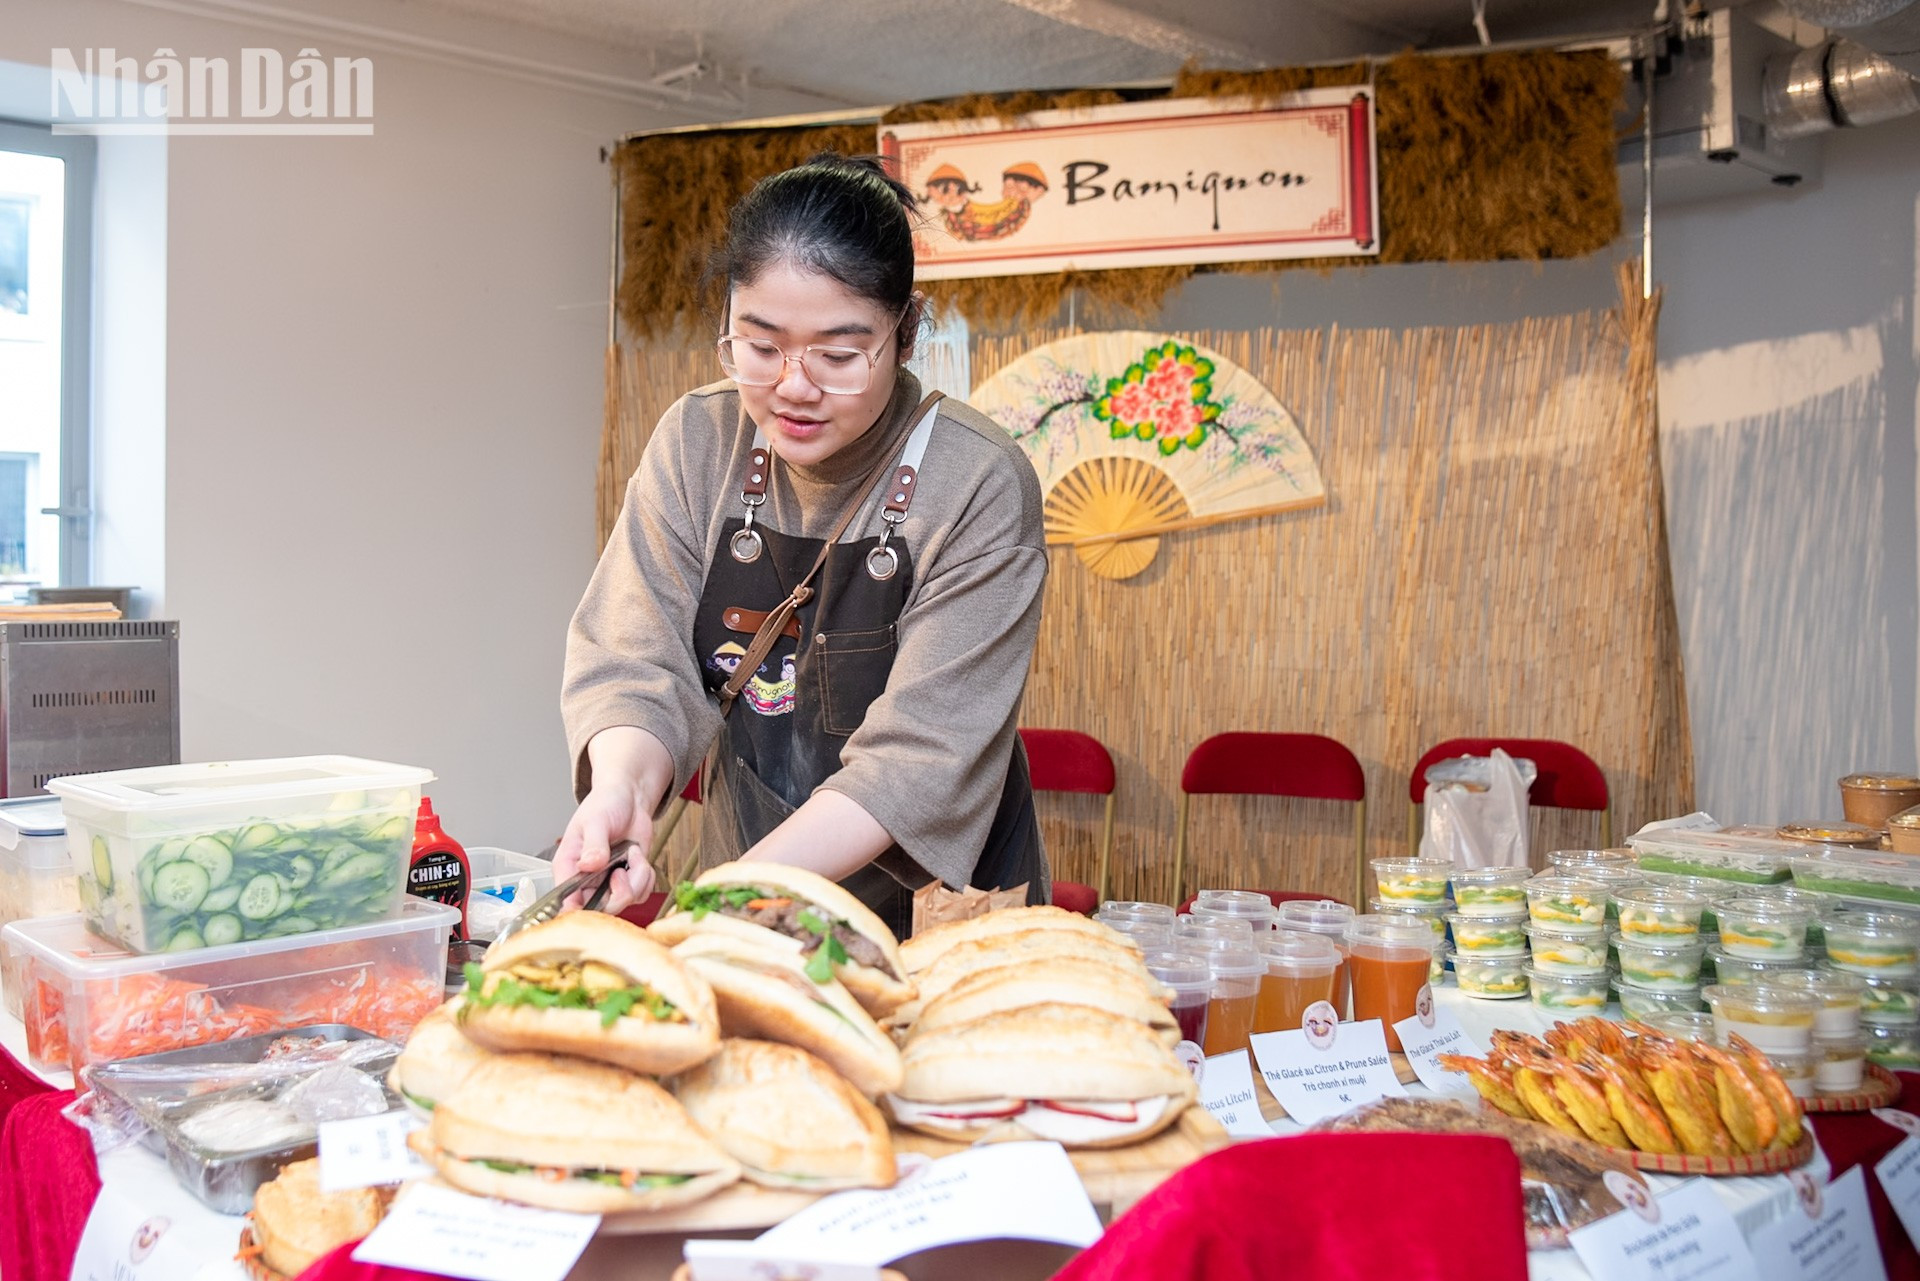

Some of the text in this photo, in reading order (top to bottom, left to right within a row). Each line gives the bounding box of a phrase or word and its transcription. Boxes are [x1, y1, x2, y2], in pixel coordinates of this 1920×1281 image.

[1061, 160, 1309, 231] Bamignon
[410, 862, 460, 883] CHIN-SU
[1265, 1054, 1388, 1081] Thé Glacé au Citron & Prune Salée
[1317, 1077, 1340, 1090] chanh
